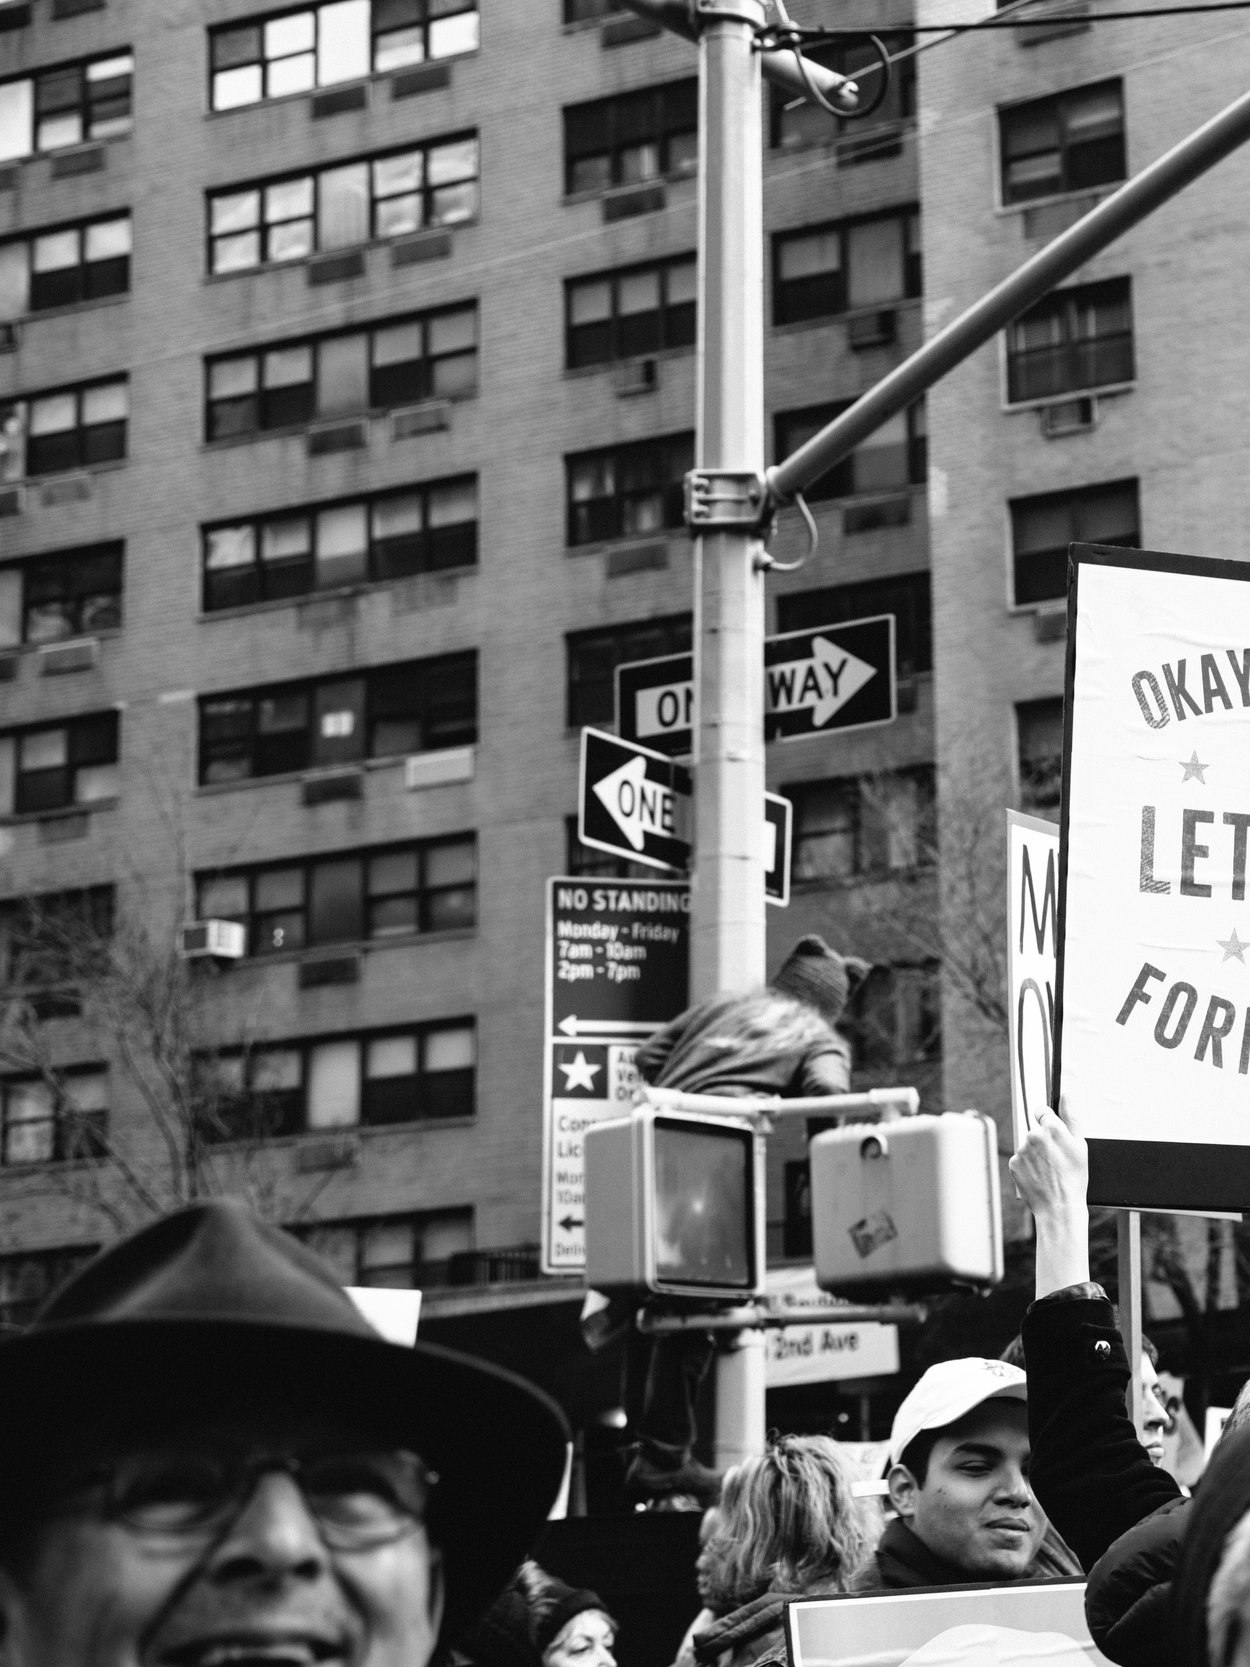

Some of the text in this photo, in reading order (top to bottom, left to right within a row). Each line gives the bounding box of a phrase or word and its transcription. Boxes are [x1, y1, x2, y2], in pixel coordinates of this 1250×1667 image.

[768, 658, 848, 708] WAY
[618, 778, 677, 833] ONE
[557, 888, 691, 913] NO STANDING
[557, 920, 619, 943] Monday
[631, 921, 680, 944] Friday
[557, 939, 593, 960] 7am
[605, 941, 647, 960] 10am
[557, 960, 594, 983] 2pm
[606, 961, 641, 984] 7pm
[774, 1331, 813, 1360] 2nd
[820, 1330, 859, 1354] Ave
